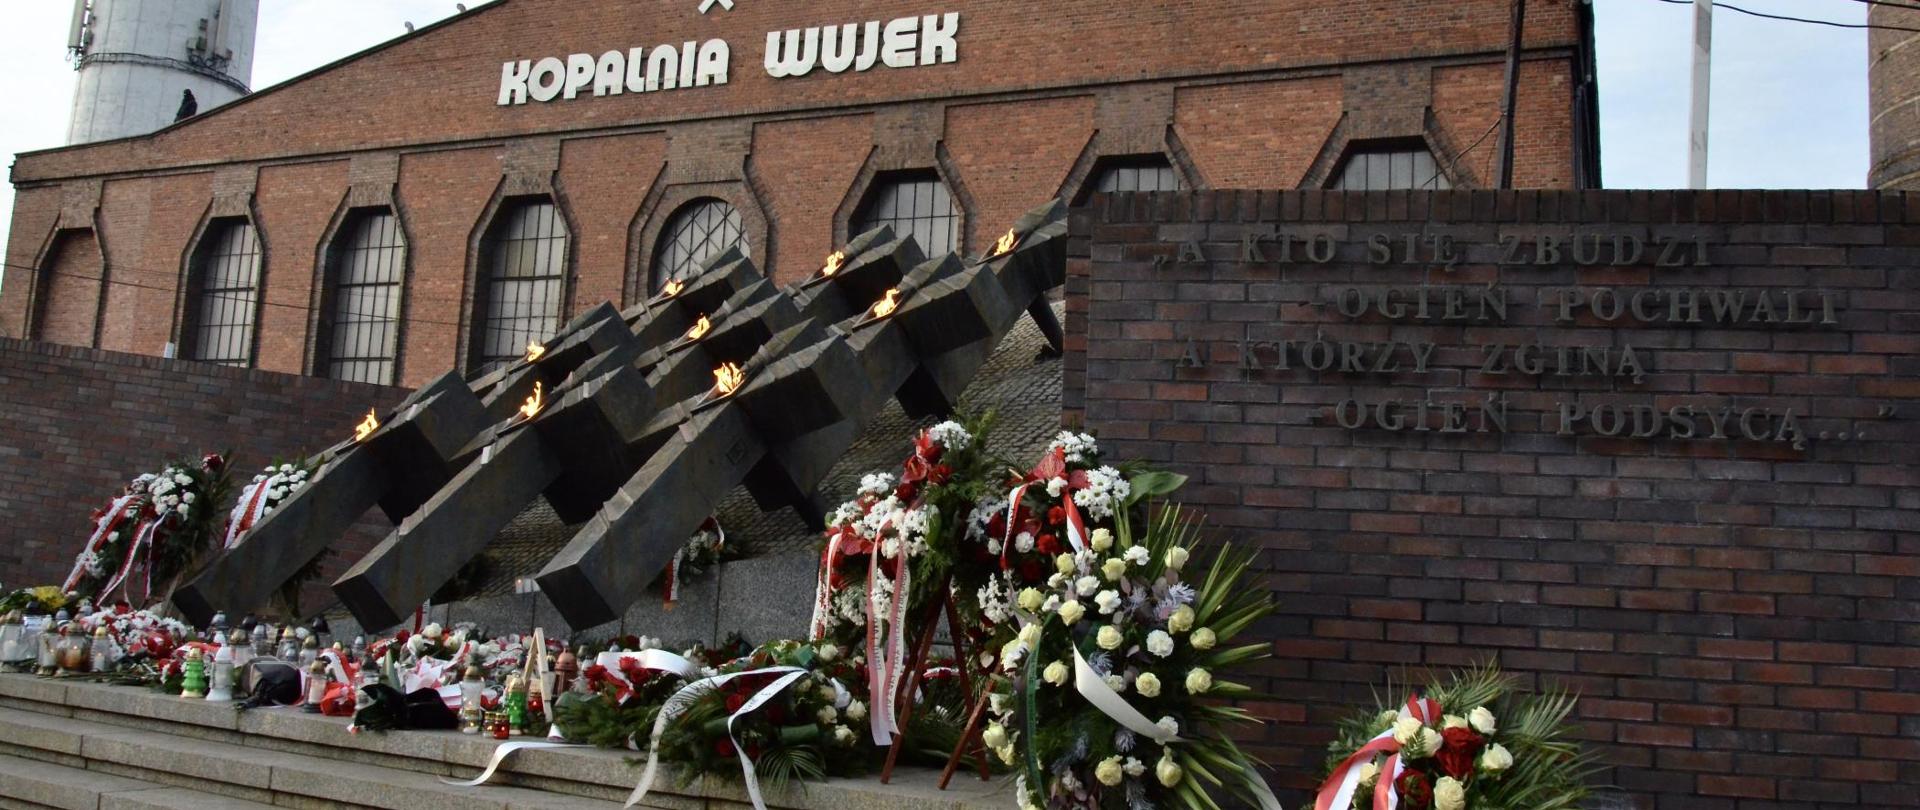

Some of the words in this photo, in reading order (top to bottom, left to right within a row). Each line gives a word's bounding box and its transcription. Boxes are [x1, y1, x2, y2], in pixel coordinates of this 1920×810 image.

[497, 38, 730, 105] KOPALNIA
[763, 12, 959, 78] WUJEK
[1242, 233, 1337, 264] KTO
[1367, 232, 1458, 272] SIĘ
[1498, 232, 1712, 268] ZBUDZI
[1555, 287, 1840, 325] POCHWALI
[1175, 337, 1205, 369] A
[1242, 328, 1437, 374] KTÓRZY
[1479, 344, 1647, 385] ZGINĄ
